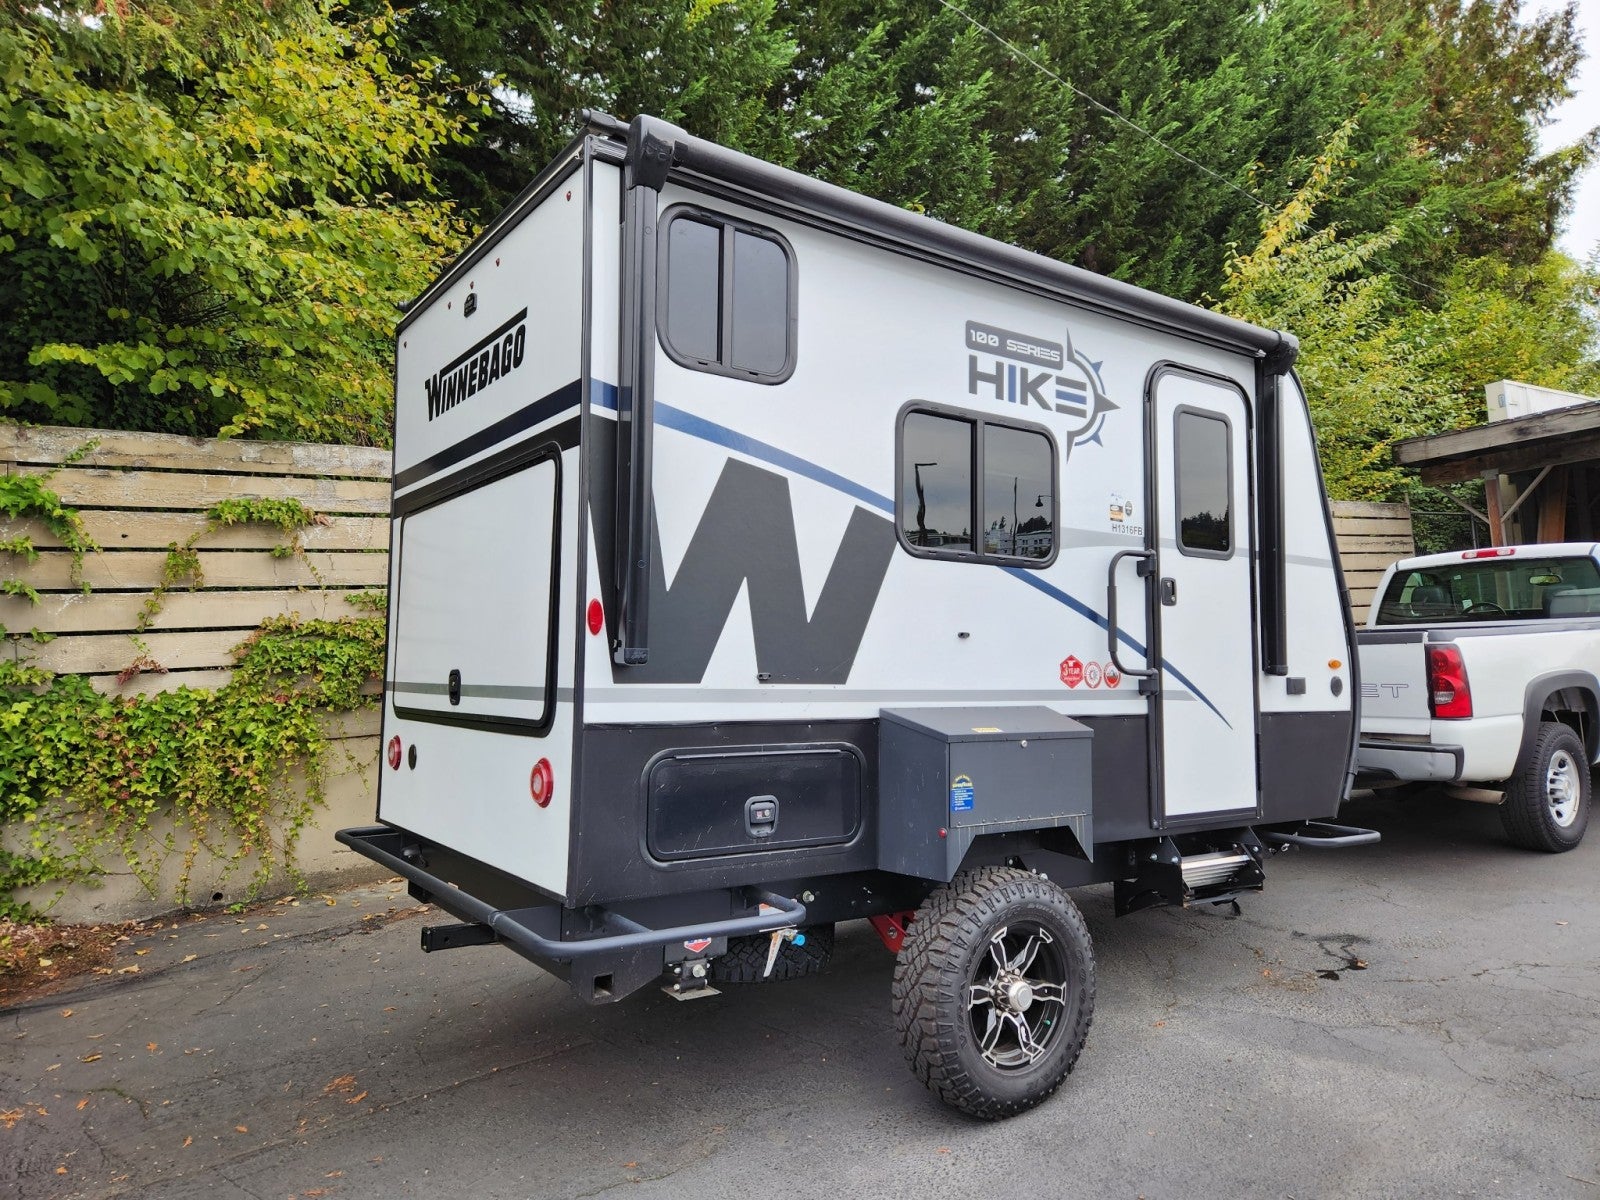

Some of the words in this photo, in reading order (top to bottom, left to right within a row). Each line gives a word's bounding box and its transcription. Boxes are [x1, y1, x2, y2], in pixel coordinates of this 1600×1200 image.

[970, 329, 999, 347] 100
[1007, 339, 1061, 363] SERIES
[425, 322, 526, 422] WINNEBAGO
[968, 354, 1087, 419] HIKE
[1112, 523, 1143, 536] H1316FB
